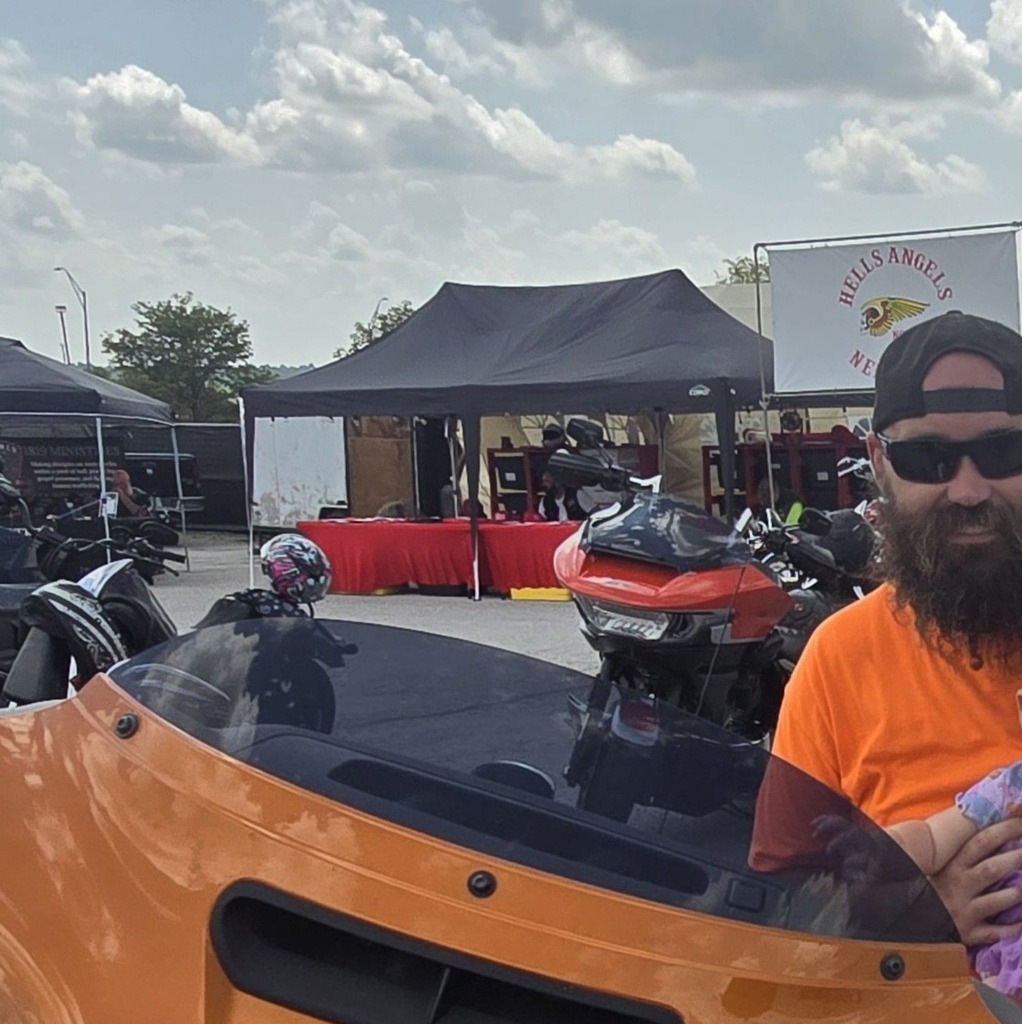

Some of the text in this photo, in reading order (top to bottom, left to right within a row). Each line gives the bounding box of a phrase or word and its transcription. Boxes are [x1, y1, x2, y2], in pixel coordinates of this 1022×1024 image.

[839, 246, 953, 308] HELLS ANGELS
[850, 349, 876, 376] NE
[50, 445, 119, 457] MINISTES
